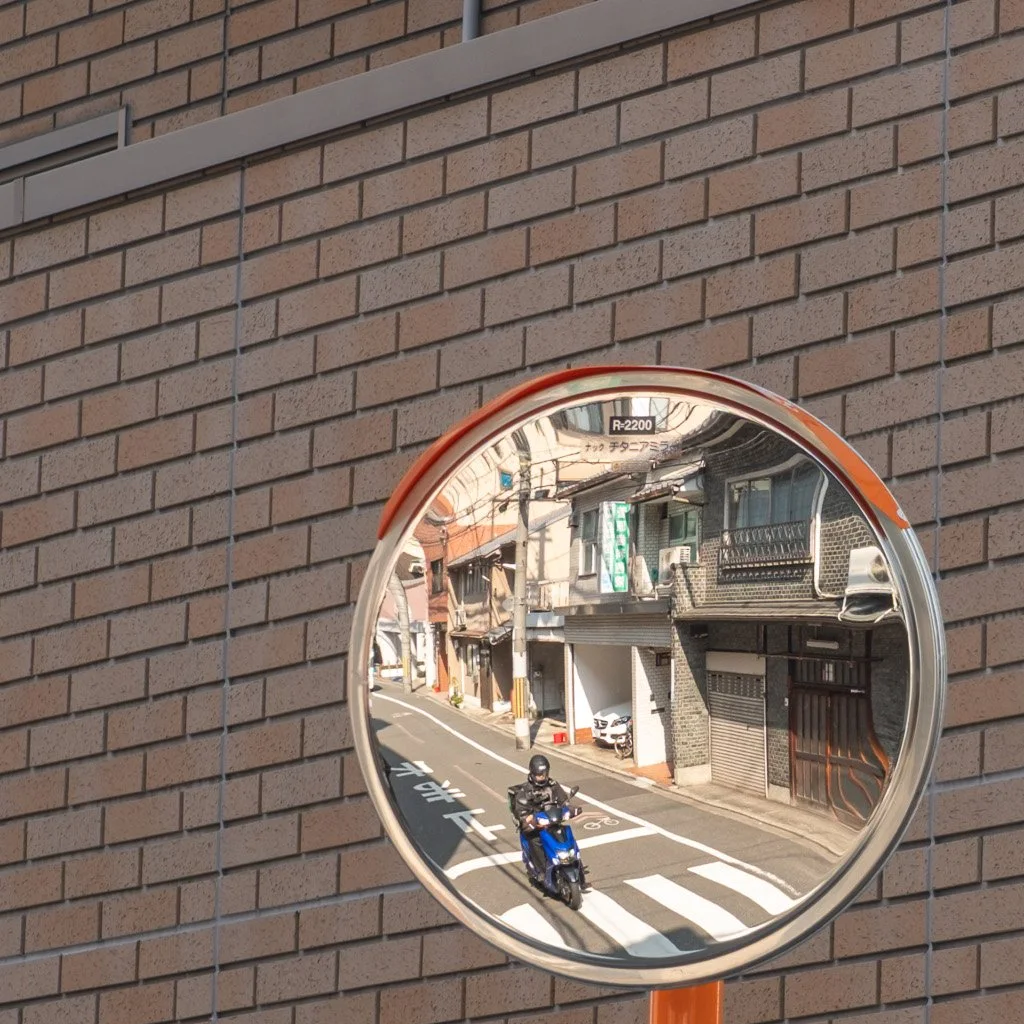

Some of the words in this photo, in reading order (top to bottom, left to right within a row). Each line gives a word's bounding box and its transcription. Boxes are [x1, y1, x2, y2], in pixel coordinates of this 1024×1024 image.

[613, 419, 652, 431] R=2200
[585, 442, 604, 452] ナック
